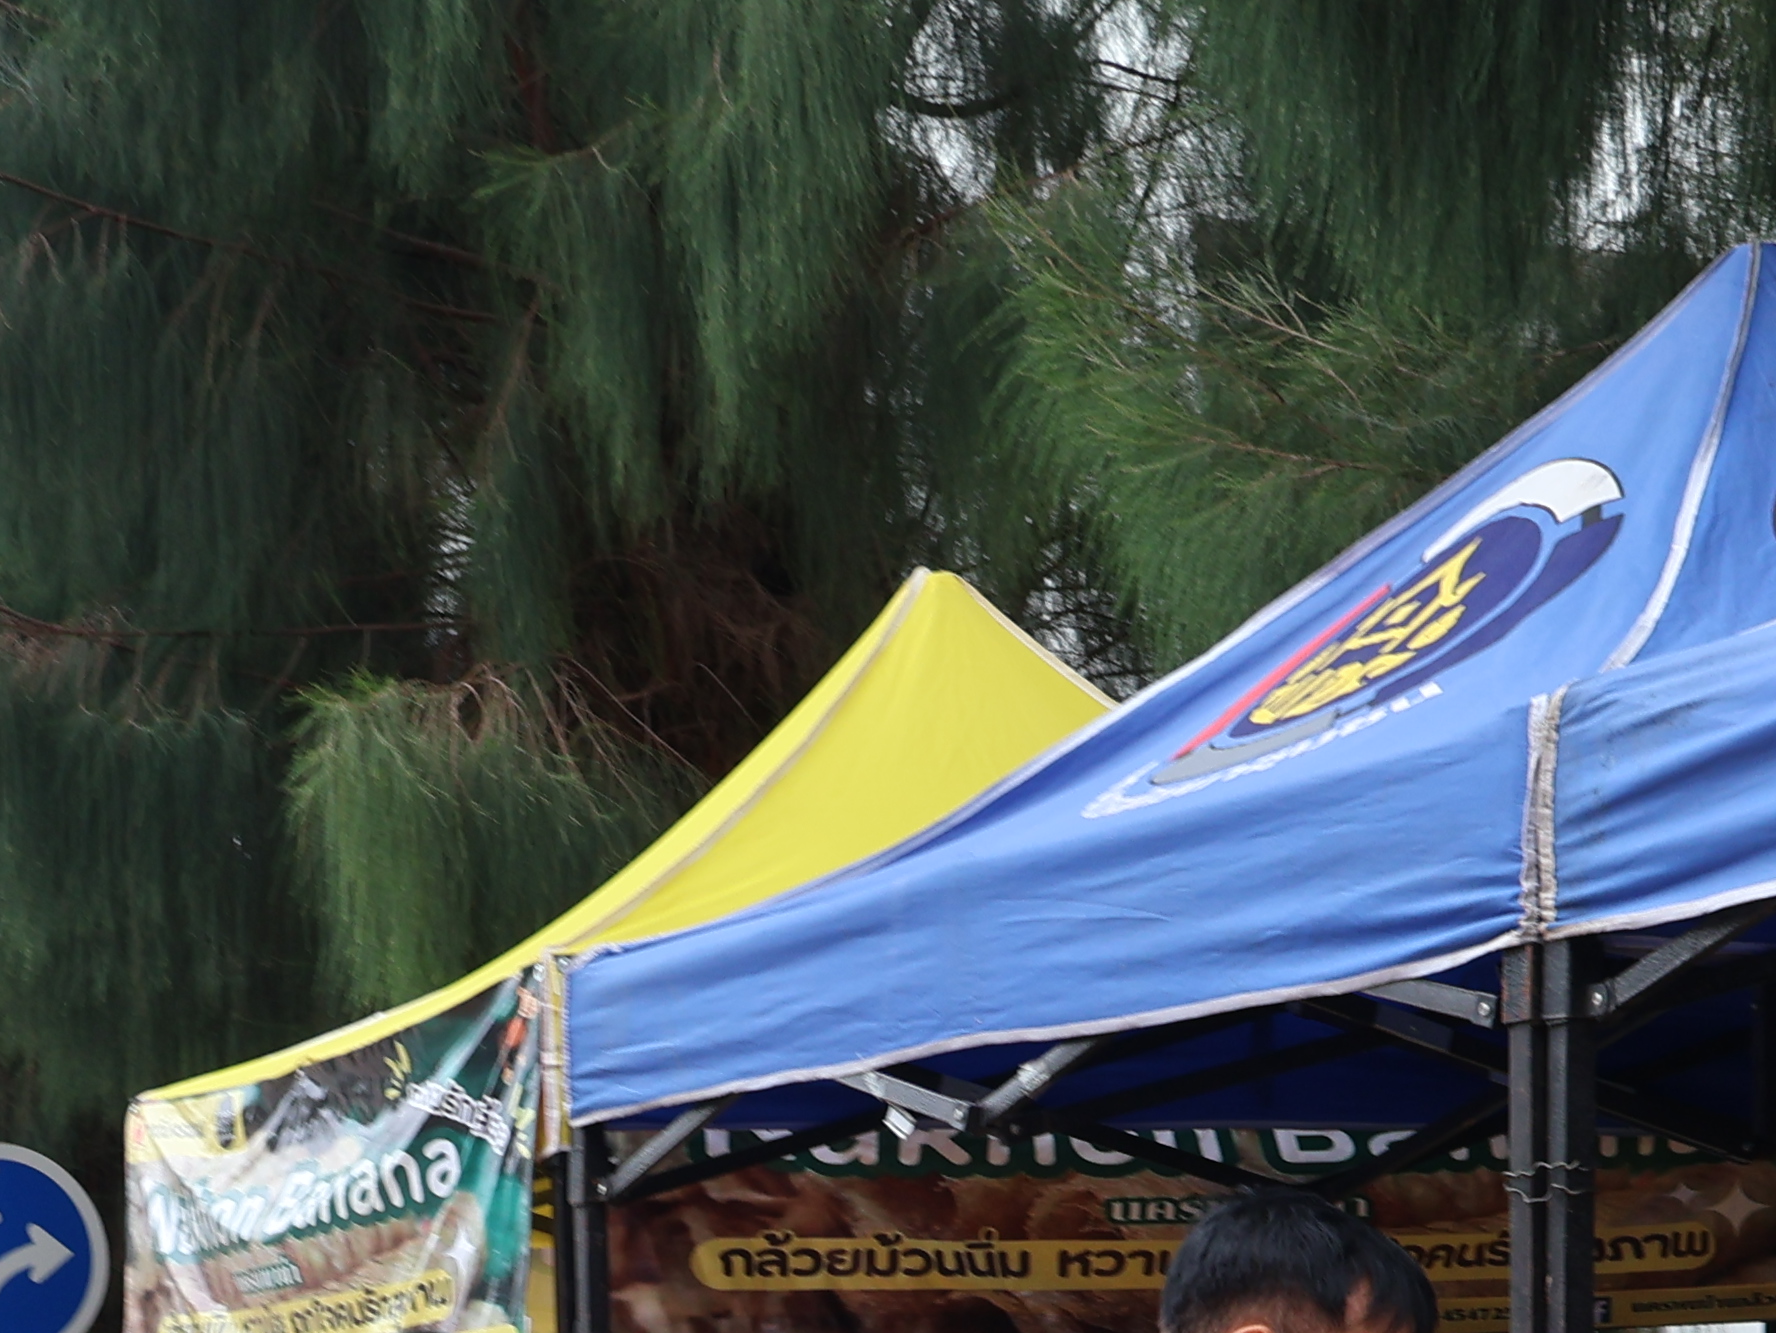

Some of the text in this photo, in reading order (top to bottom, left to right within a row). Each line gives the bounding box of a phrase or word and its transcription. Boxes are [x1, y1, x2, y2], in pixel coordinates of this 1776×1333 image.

[718, 1227, 1031, 1279] กล้วยม้วนนิ่ม
